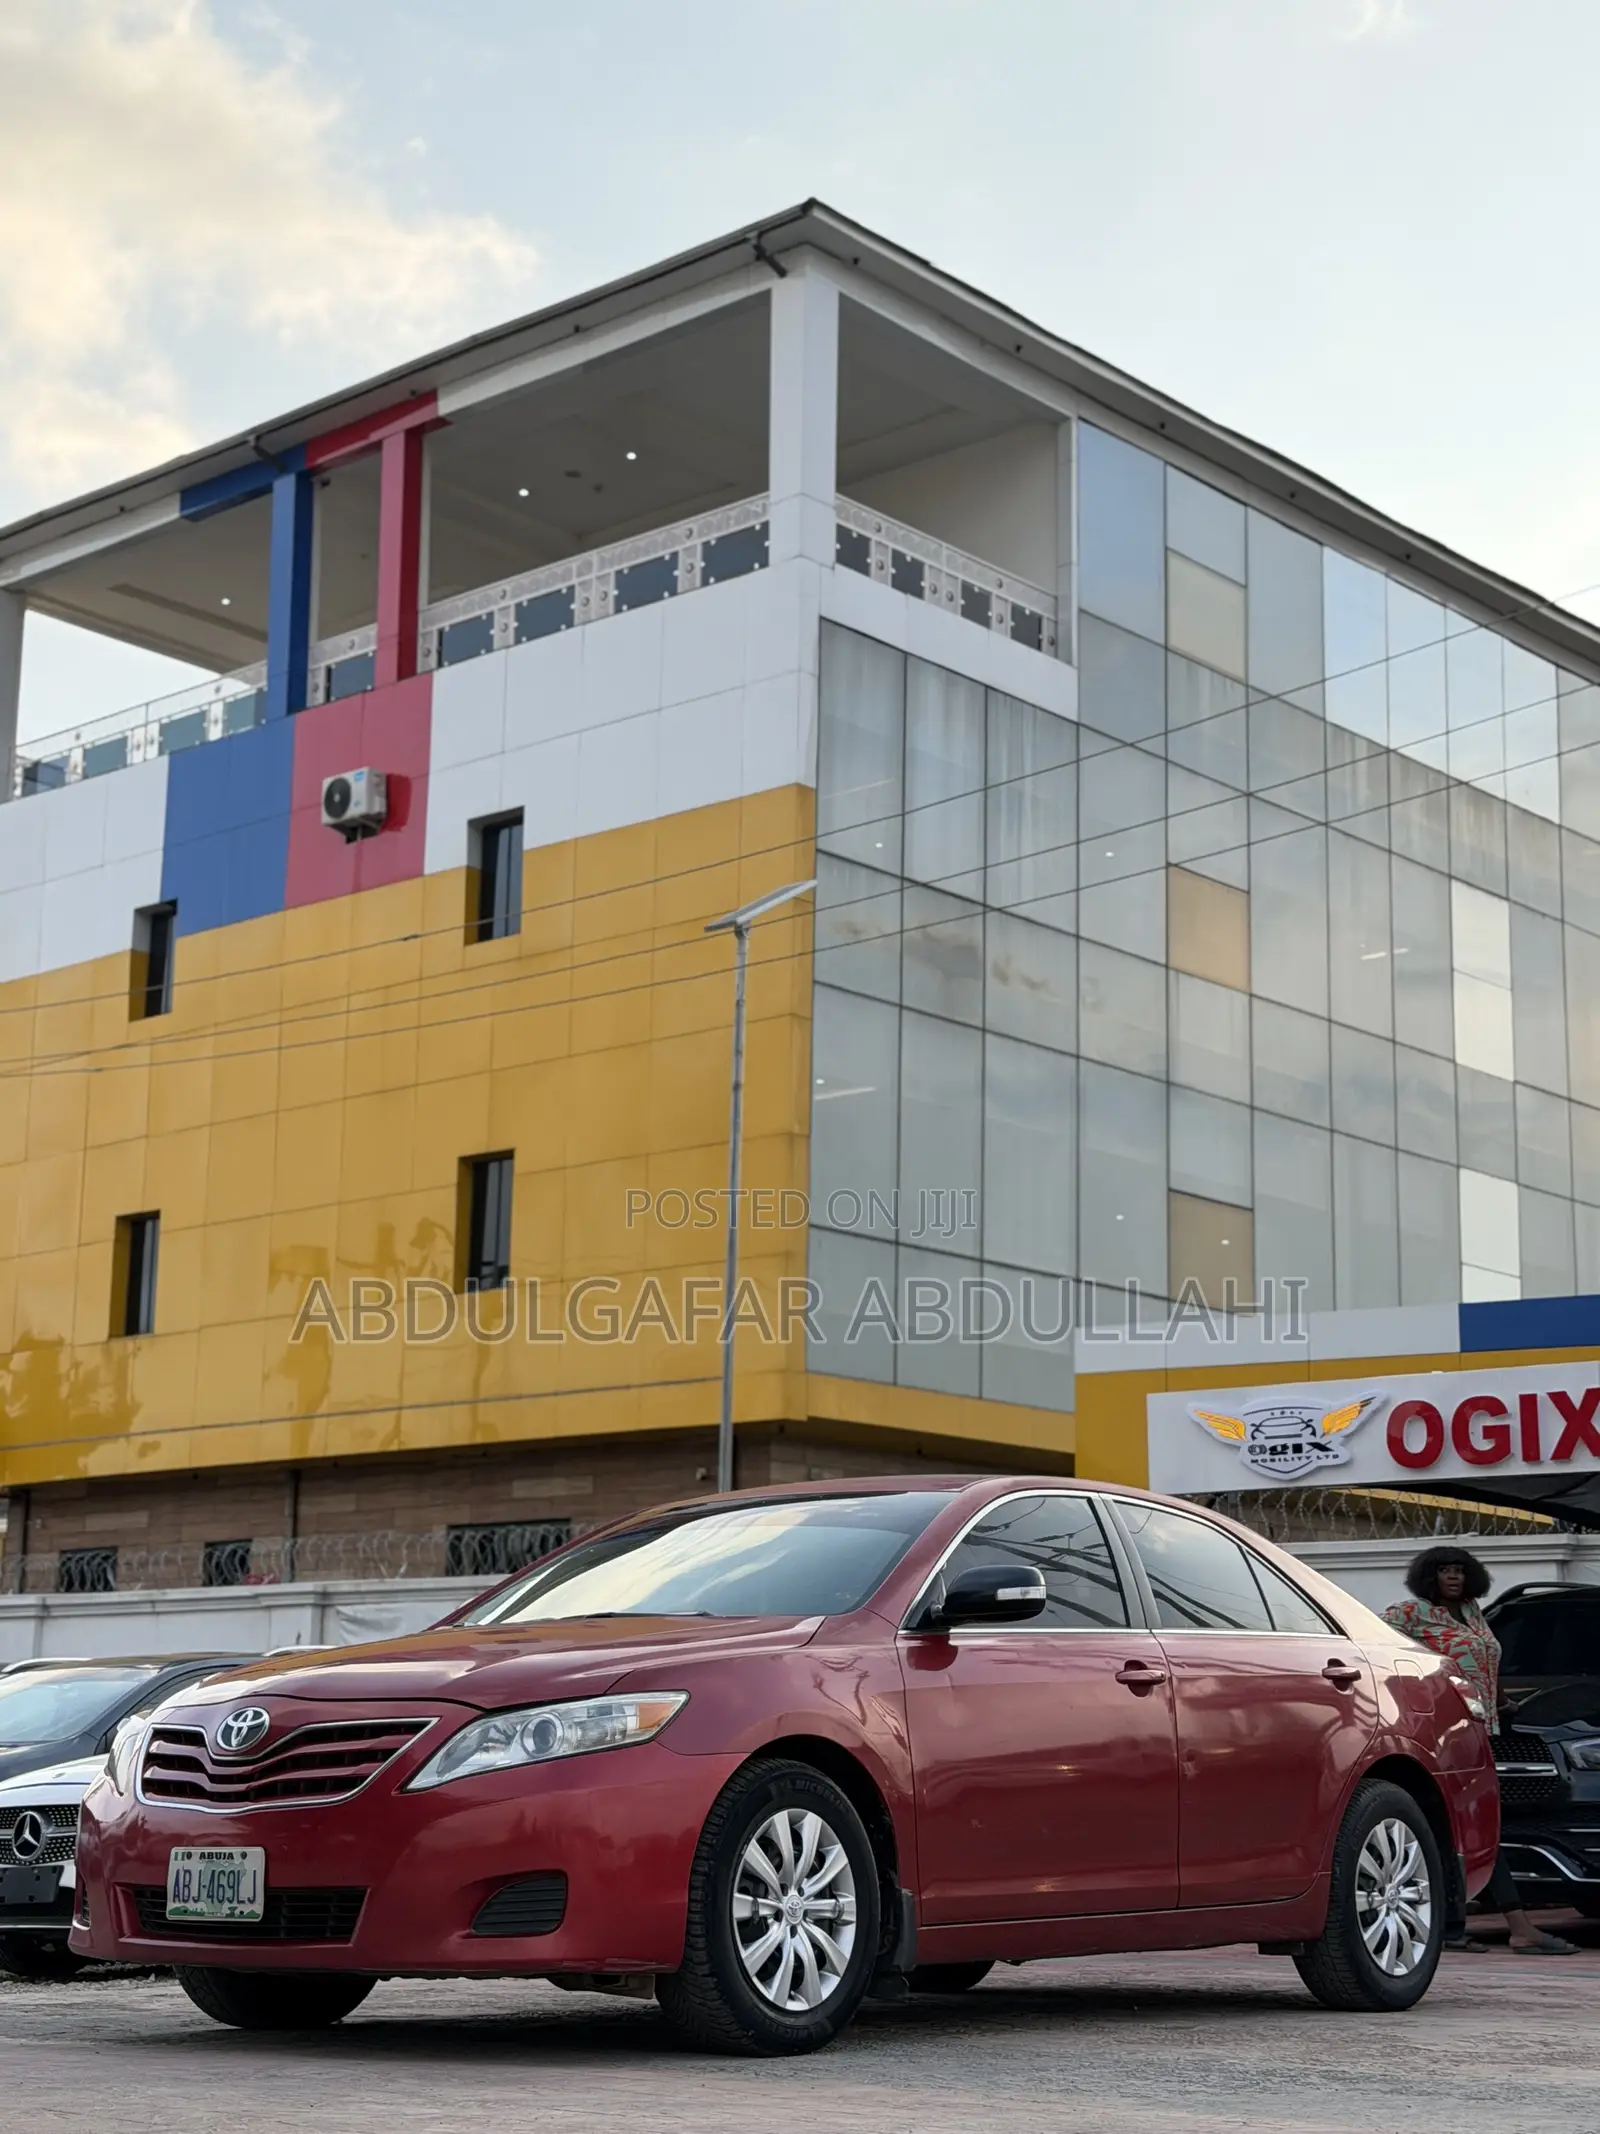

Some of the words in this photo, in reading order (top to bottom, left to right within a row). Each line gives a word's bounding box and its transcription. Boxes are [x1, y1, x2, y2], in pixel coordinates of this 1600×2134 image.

[1386, 1387, 1600, 1469] OGIX
[1250, 1455, 1312, 1464] MOBILITY
[199, 1851, 235, 1860] ABUJA
